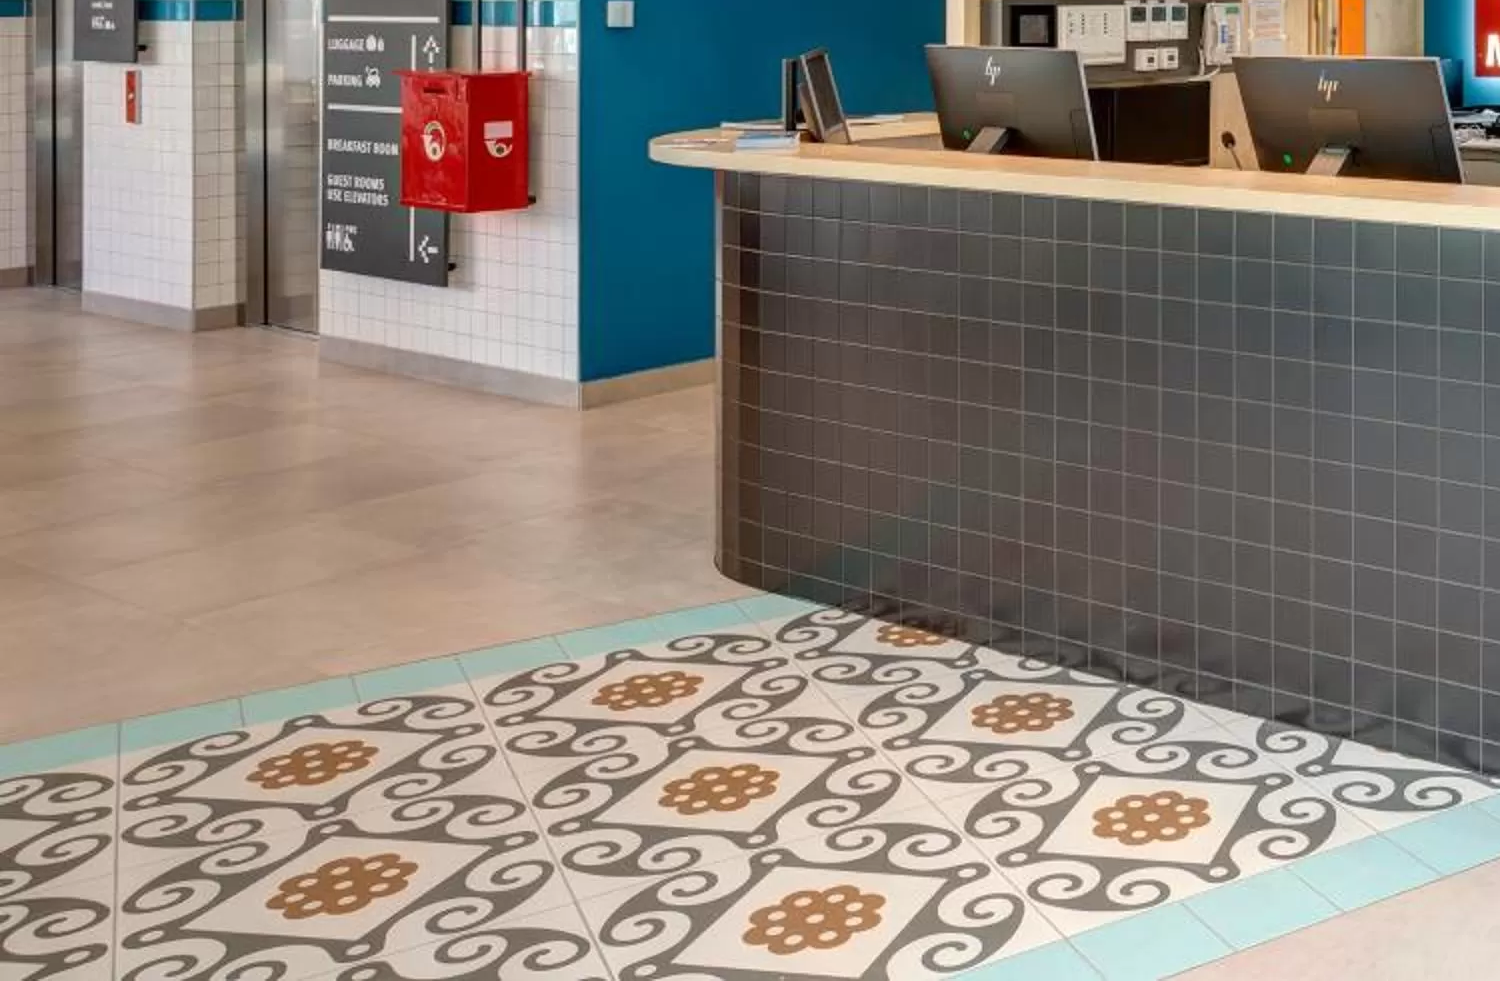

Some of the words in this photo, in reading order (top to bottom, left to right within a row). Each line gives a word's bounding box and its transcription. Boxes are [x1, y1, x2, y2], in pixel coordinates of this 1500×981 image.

[327, 38, 364, 51] LUGGAGE
[327, 74, 363, 87] PARKING
[327, 138, 371, 154] BREAKFAST
[327, 173, 353, 188] GUEST
[353, 176, 385, 190] ROOMS
[327, 188, 343, 202] USE
[343, 190, 389, 207] ELEVATORS
